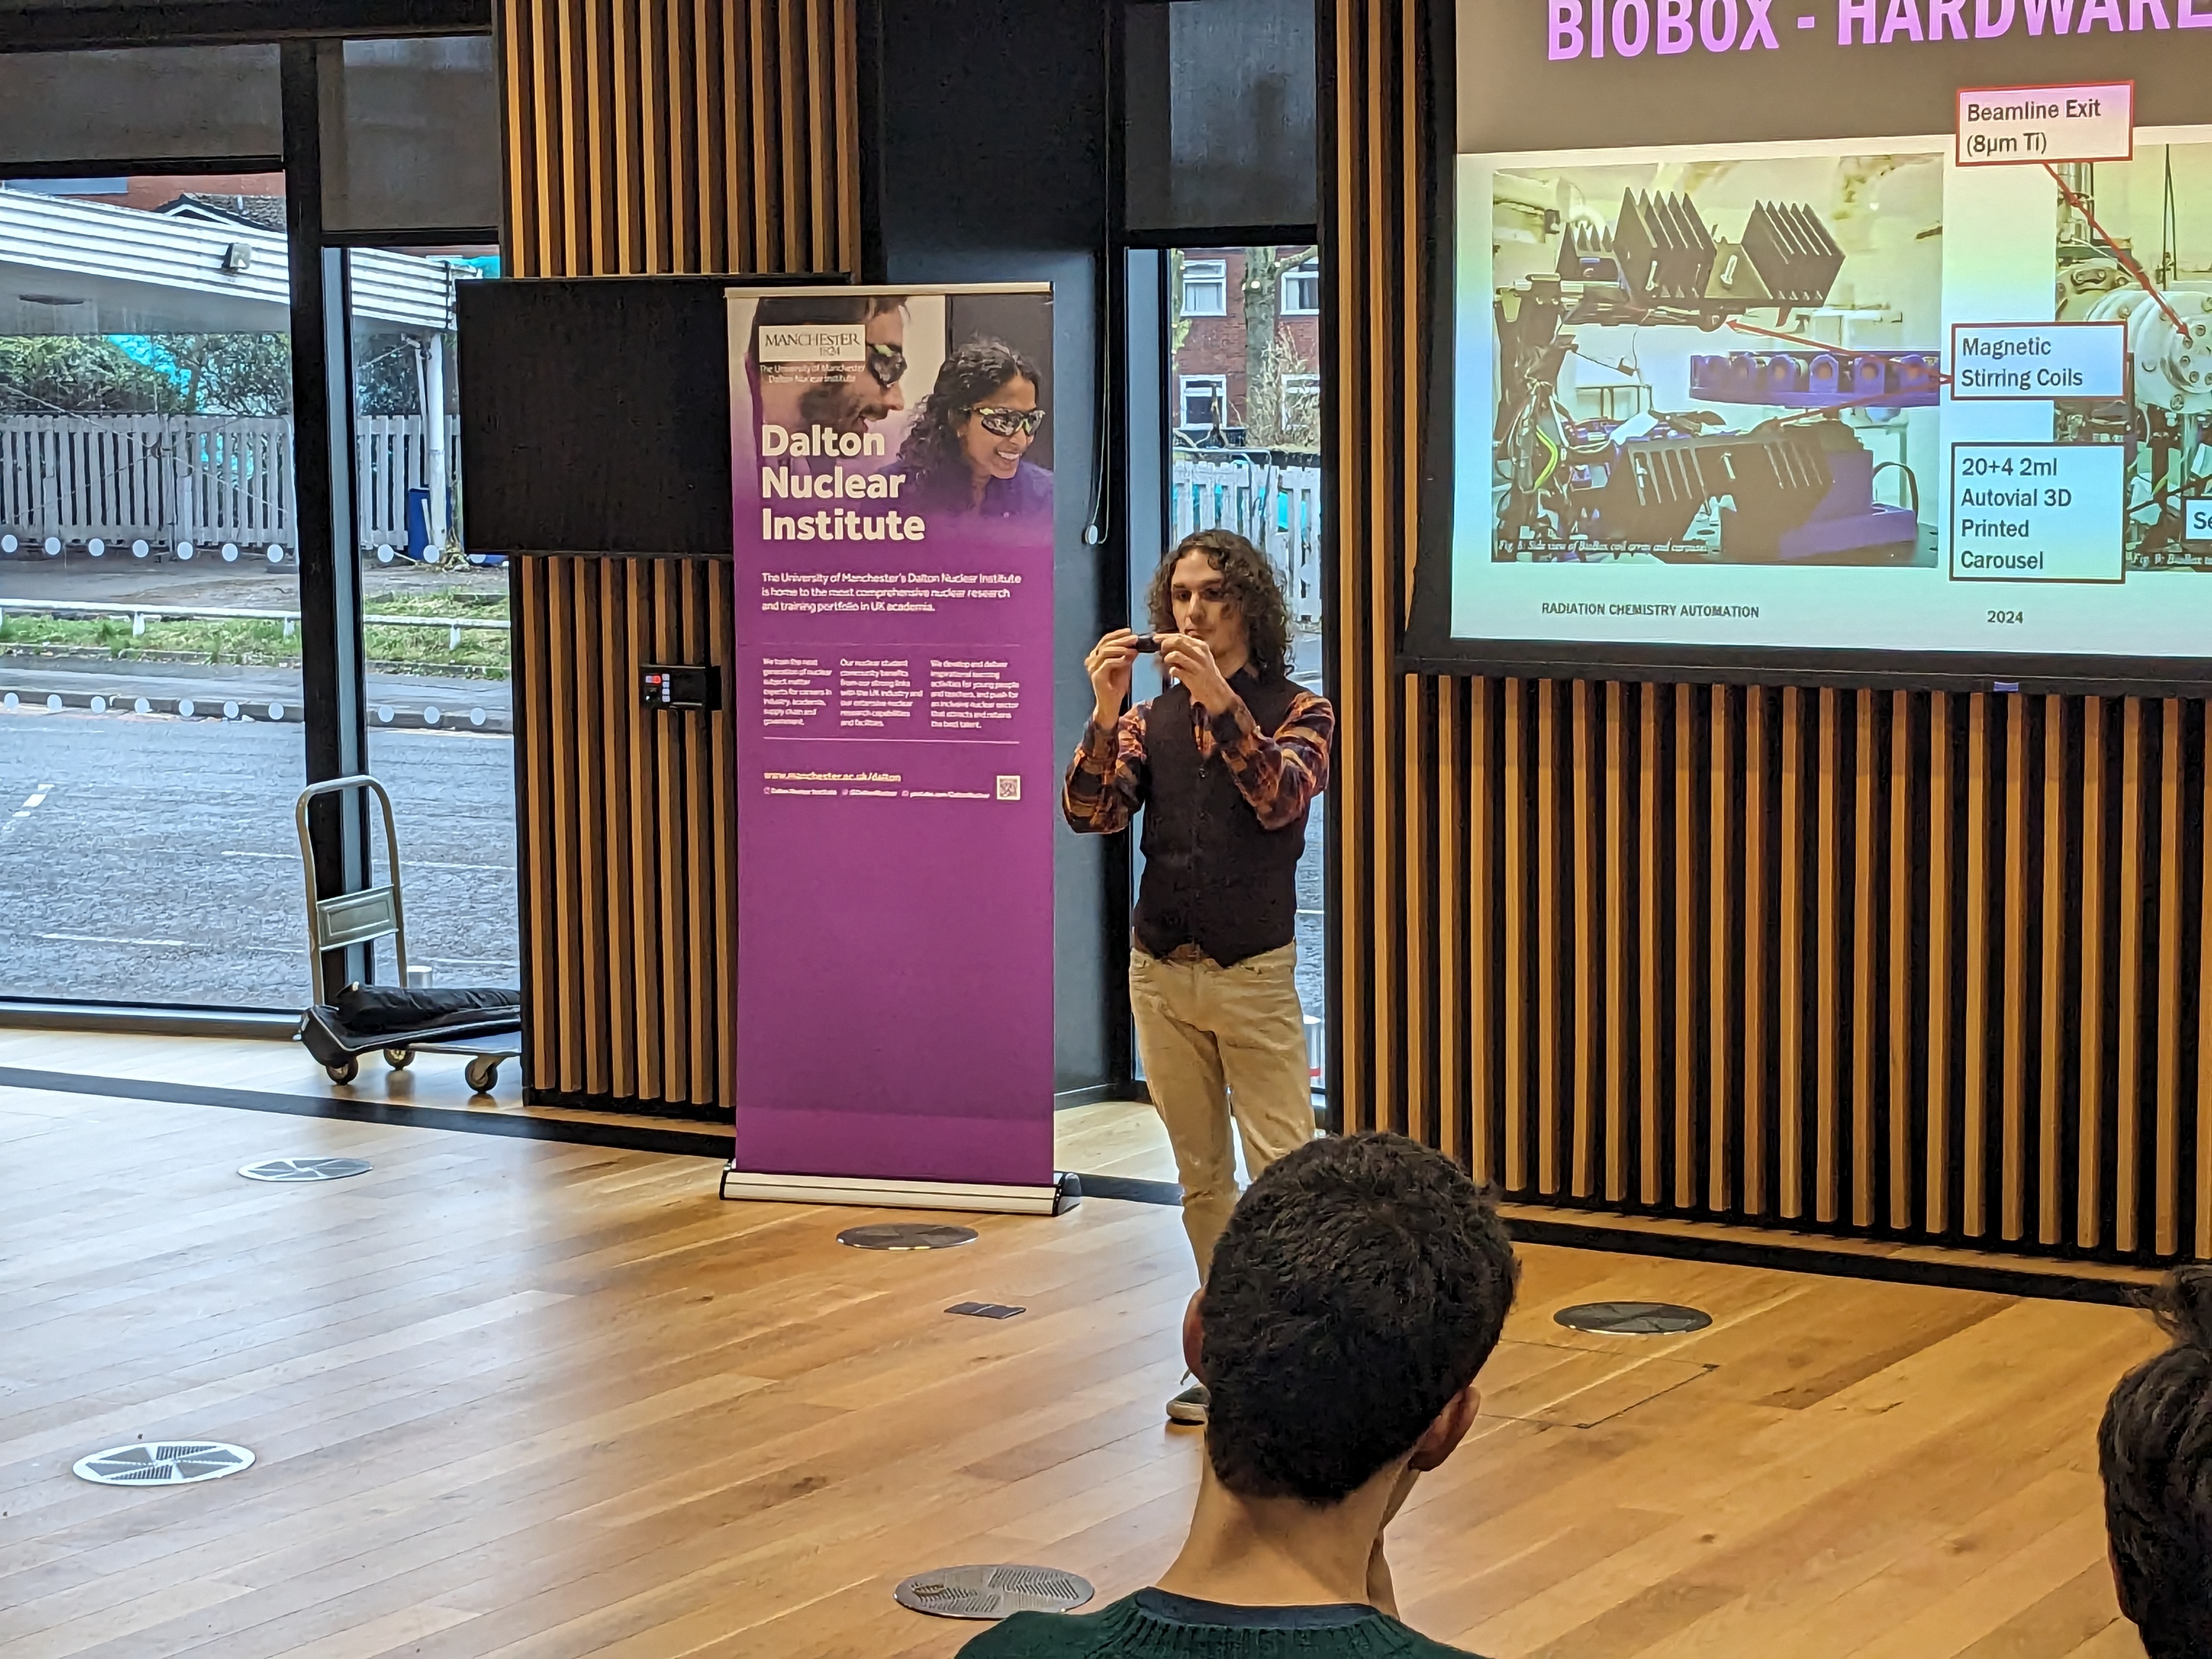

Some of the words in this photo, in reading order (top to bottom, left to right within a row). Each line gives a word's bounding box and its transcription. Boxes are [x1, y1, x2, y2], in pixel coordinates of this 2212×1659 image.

[1548, 0, 1780, 60] BIOBOX
[1797, 16, 1815, 29] -
[1967, 100, 2059, 122] Beamline
[2066, 98, 2101, 118] Exit
[765, 333, 860, 347] MANCHESTER
[1962, 336, 2051, 359] Magnetic
[1961, 368, 2031, 391] Stirring
[2037, 368, 2083, 386] Coils
[762, 424, 885, 456] Dalton
[1962, 458, 2014, 476] 20+4
[2019, 458, 2057, 476] 2ml
[762, 466, 906, 499] Nuclear
[1961, 488, 2038, 506] Autovial
[2044, 488, 2072, 506] 3D
[763, 508, 926, 540] Institute
[1961, 518, 2029, 537] Printed
[1961, 550, 2044, 569] Carousel
[761, 572, 780, 583] The
[781, 572, 829, 586] University
[830, 572, 841, 583] of
[908, 573, 940, 583] Dalton
[761, 587, 770, 596] is
[799, 586, 810, 596] to
[811, 586, 827, 596] the
[967, 588, 1011, 598] research
[761, 601, 779, 611] and
[781, 601, 817, 613] training
[860, 601, 870, 611] in
[871, 601, 886, 611] UK
[1542, 602, 1605, 616] RADIATION
[1609, 603, 1677, 617] CHEMISTRY
[1680, 605, 1759, 618] AUTOMATION
[1987, 610, 2023, 624] 2024
